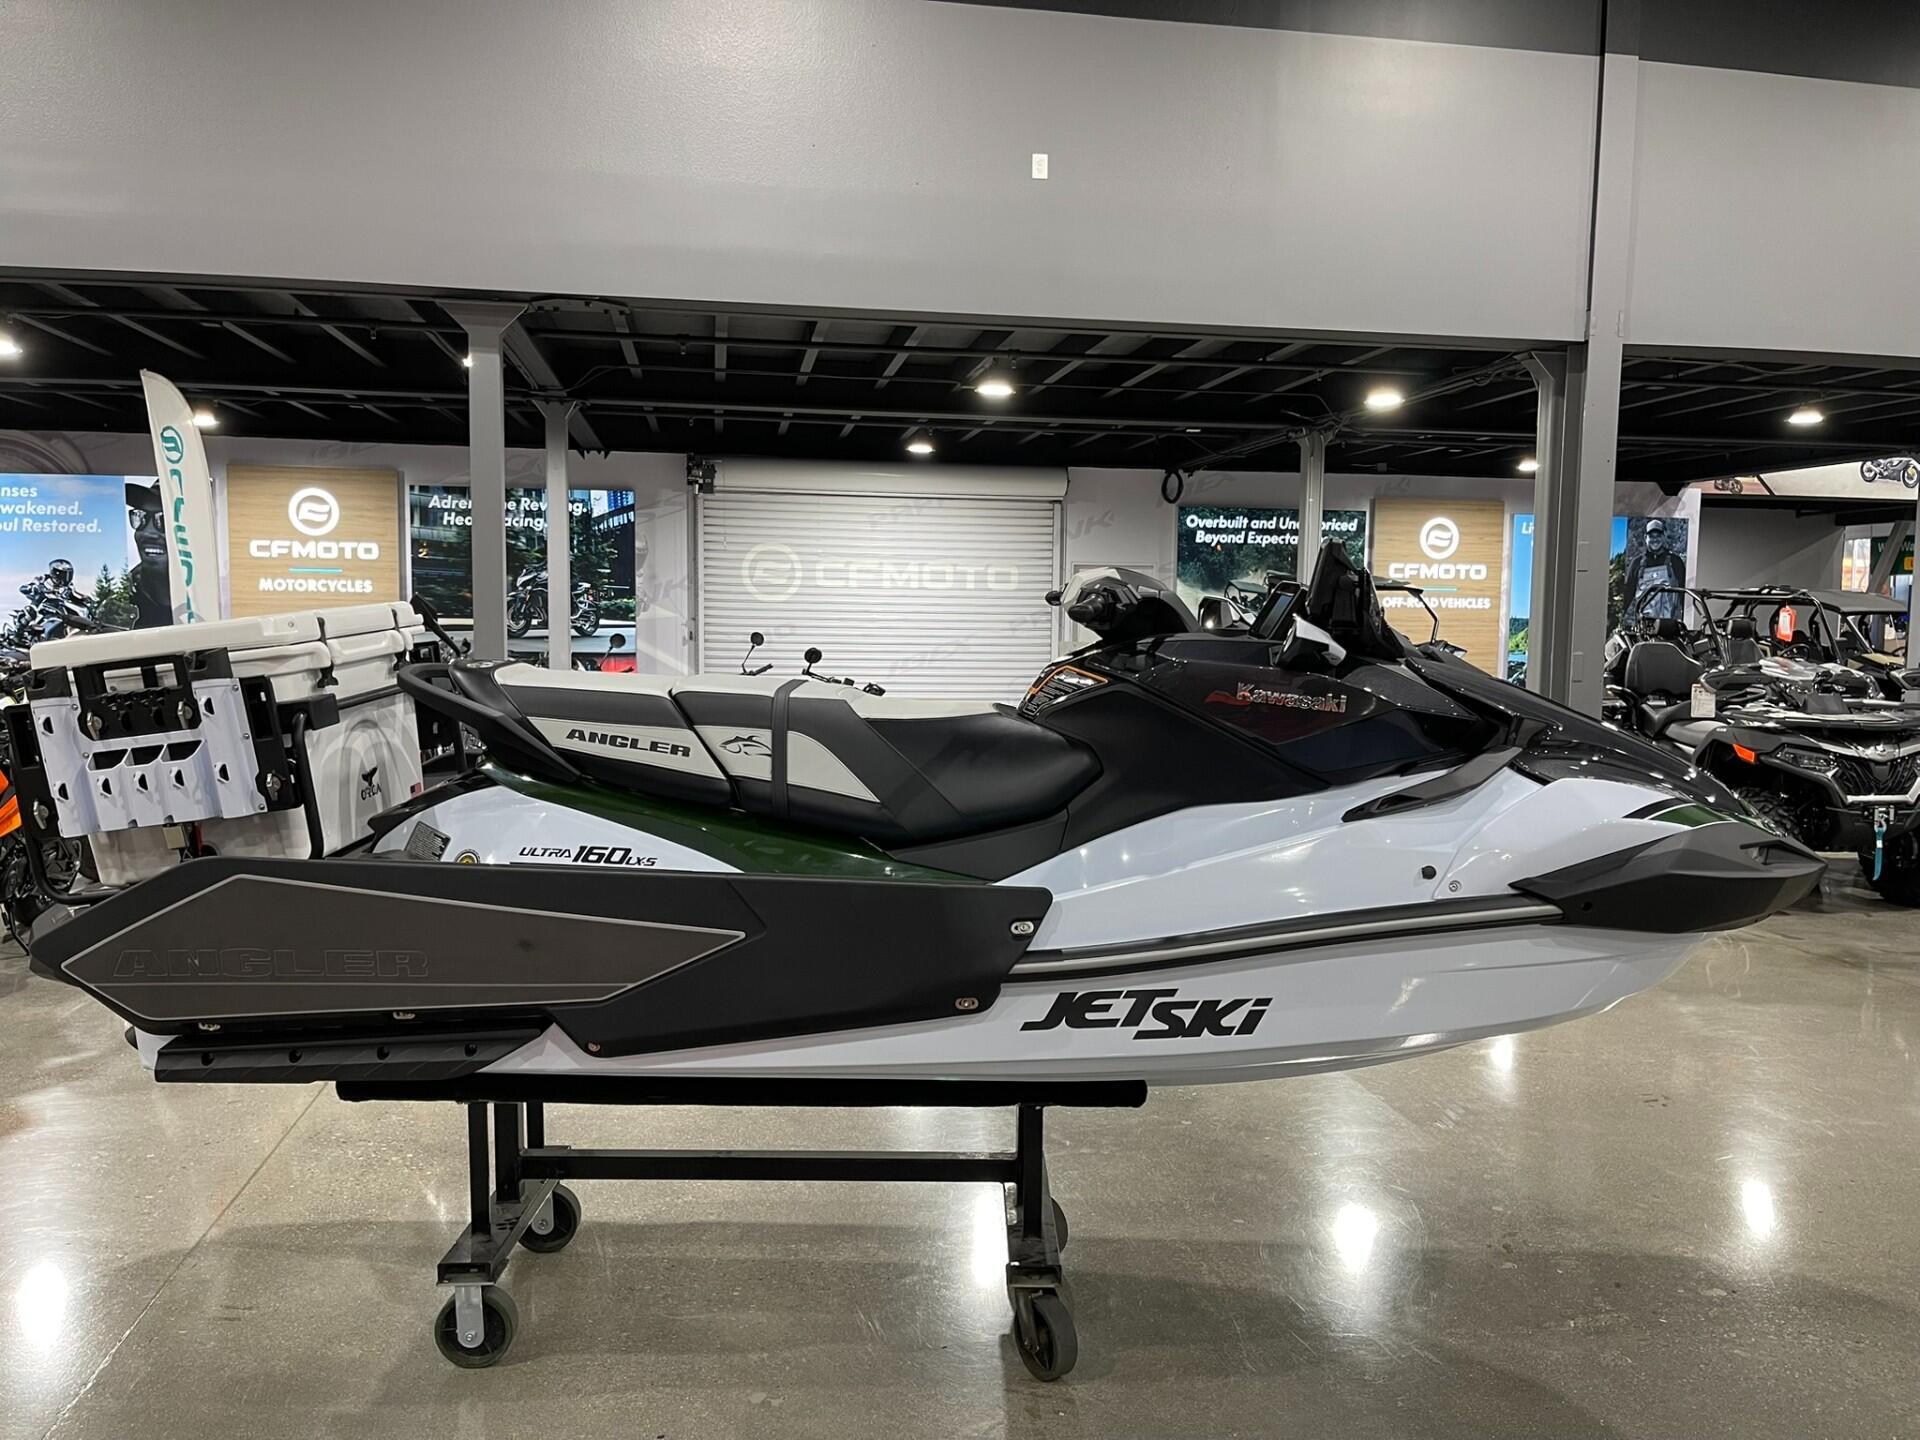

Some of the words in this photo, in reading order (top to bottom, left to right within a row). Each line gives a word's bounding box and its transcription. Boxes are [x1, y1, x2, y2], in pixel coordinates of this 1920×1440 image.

[0, 487, 38, 497] nses
[0, 500, 83, 515] wakened.
[22, 518, 102, 533] Restored.
[504, 514, 548, 531] acing.
[1186, 514, 1249, 529] Overbuilt
[1250, 516, 1276, 530] and
[1195, 530, 1246, 546] Beyond
[249, 540, 380, 560] CFMOTO
[815, 560, 1019, 591] CFMOTO
[1388, 562, 1488, 580] CFMOTO
[258, 578, 373, 593] MOTORCYCLES
[1440, 597, 1491, 609] VEHICLES
[1236, 681, 1347, 713] Kawasaki
[566, 728, 691, 758] ANGLER
[519, 846, 572, 858] ULTRA
[572, 845, 632, 865] 160
[112, 948, 429, 977] ANGLER
